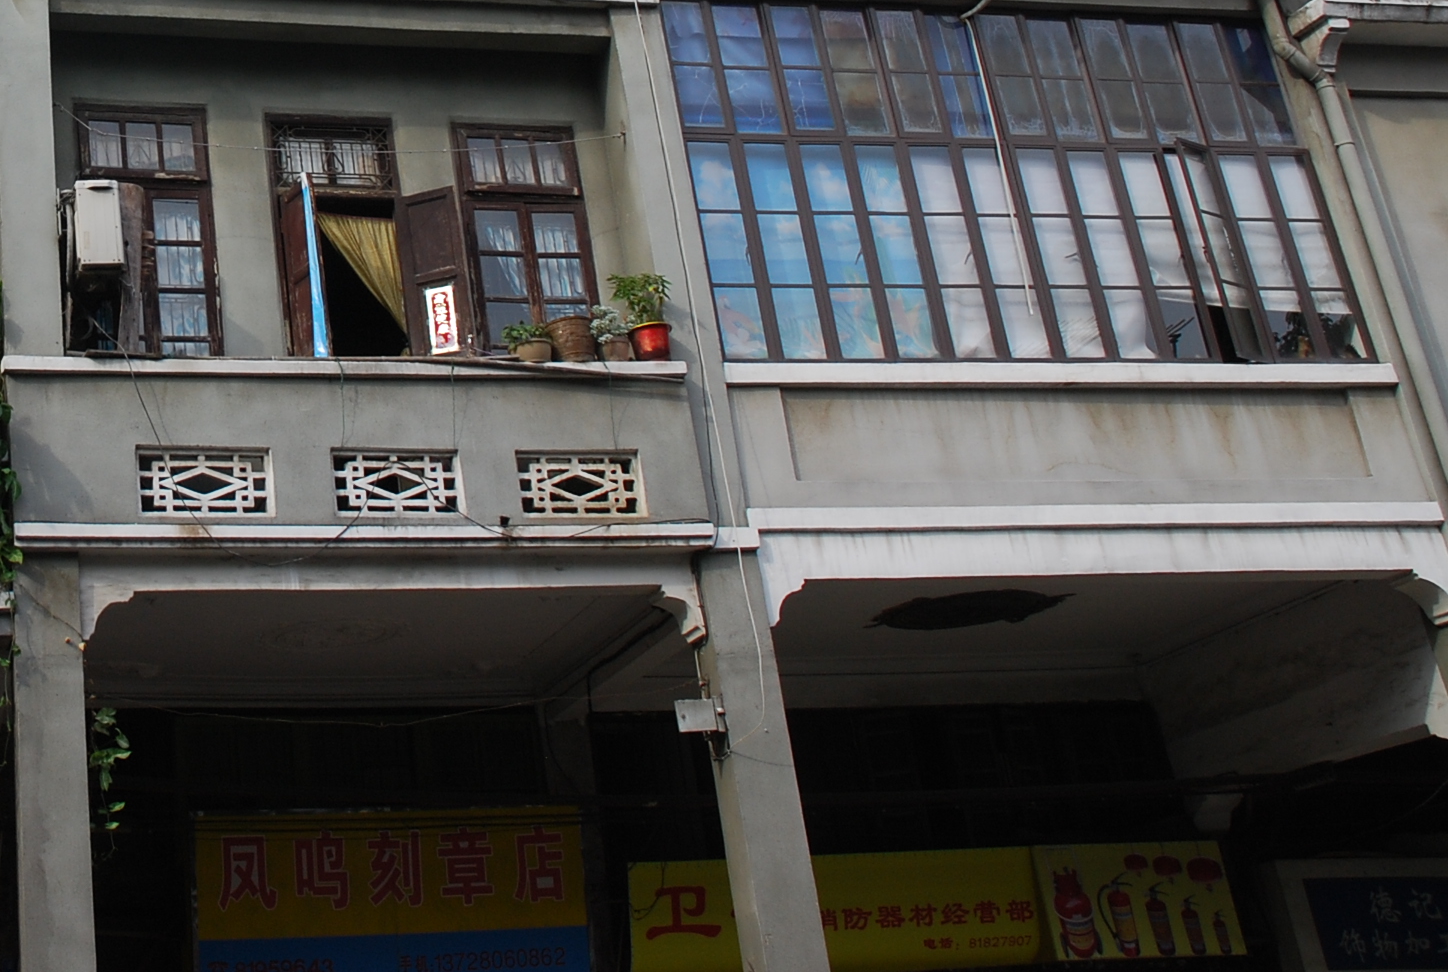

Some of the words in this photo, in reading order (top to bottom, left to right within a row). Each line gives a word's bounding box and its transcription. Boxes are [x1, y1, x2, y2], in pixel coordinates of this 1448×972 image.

[217, 826, 566, 911] 凤鸣刻章店
[646, 885, 734, 940] 卫
[1368, 886, 1443, 923] 德记
